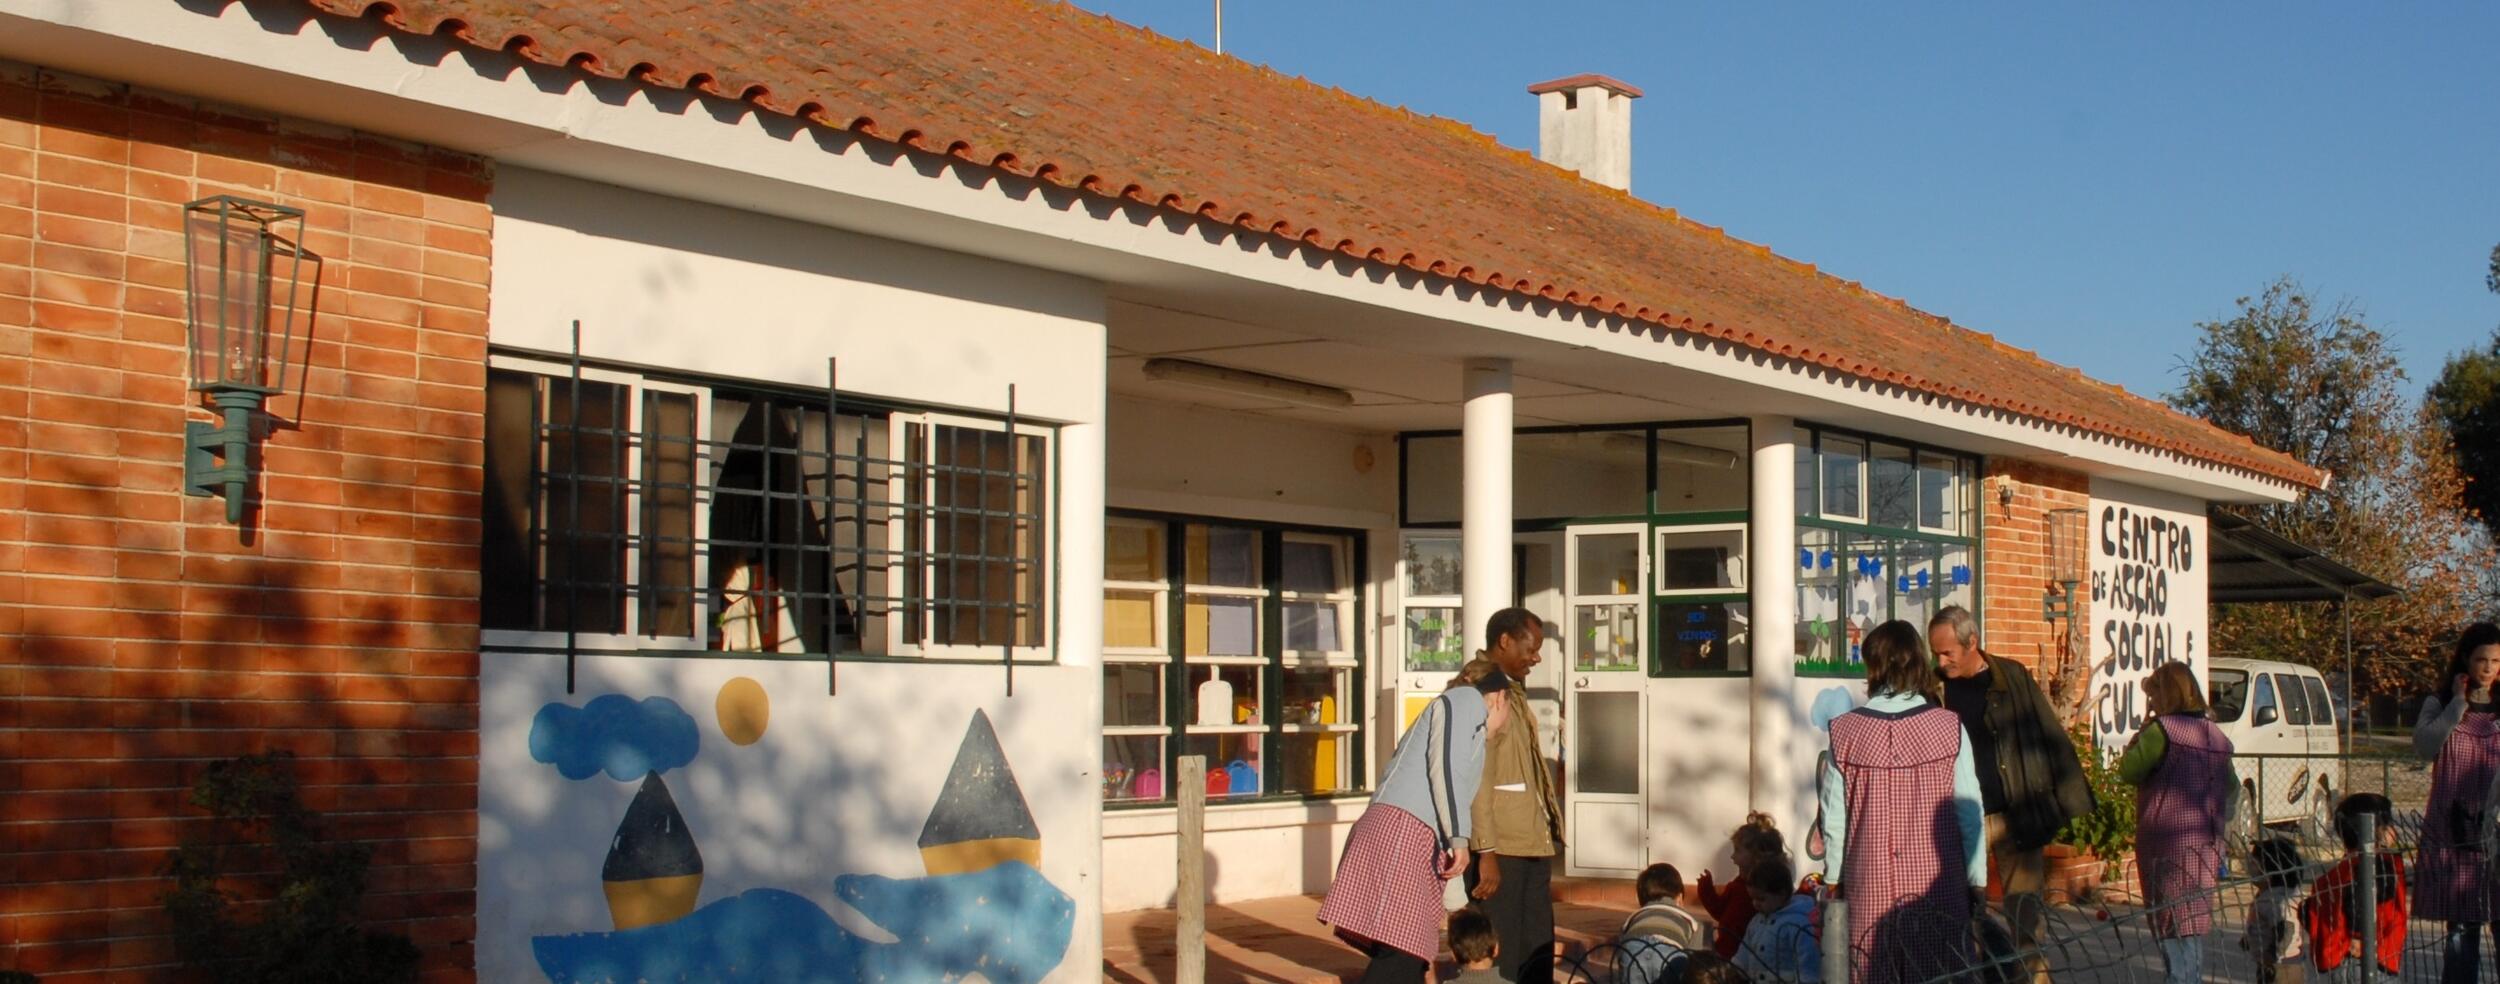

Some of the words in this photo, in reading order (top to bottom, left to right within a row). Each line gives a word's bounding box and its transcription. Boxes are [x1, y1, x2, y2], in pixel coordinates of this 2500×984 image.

[2101, 505, 2192, 574] CENTRO
[2092, 570, 2106, 602] DE
[2104, 619, 2178, 677] SOCIAL
[2186, 630, 2192, 668] E
[2098, 680, 2142, 734] CUL
